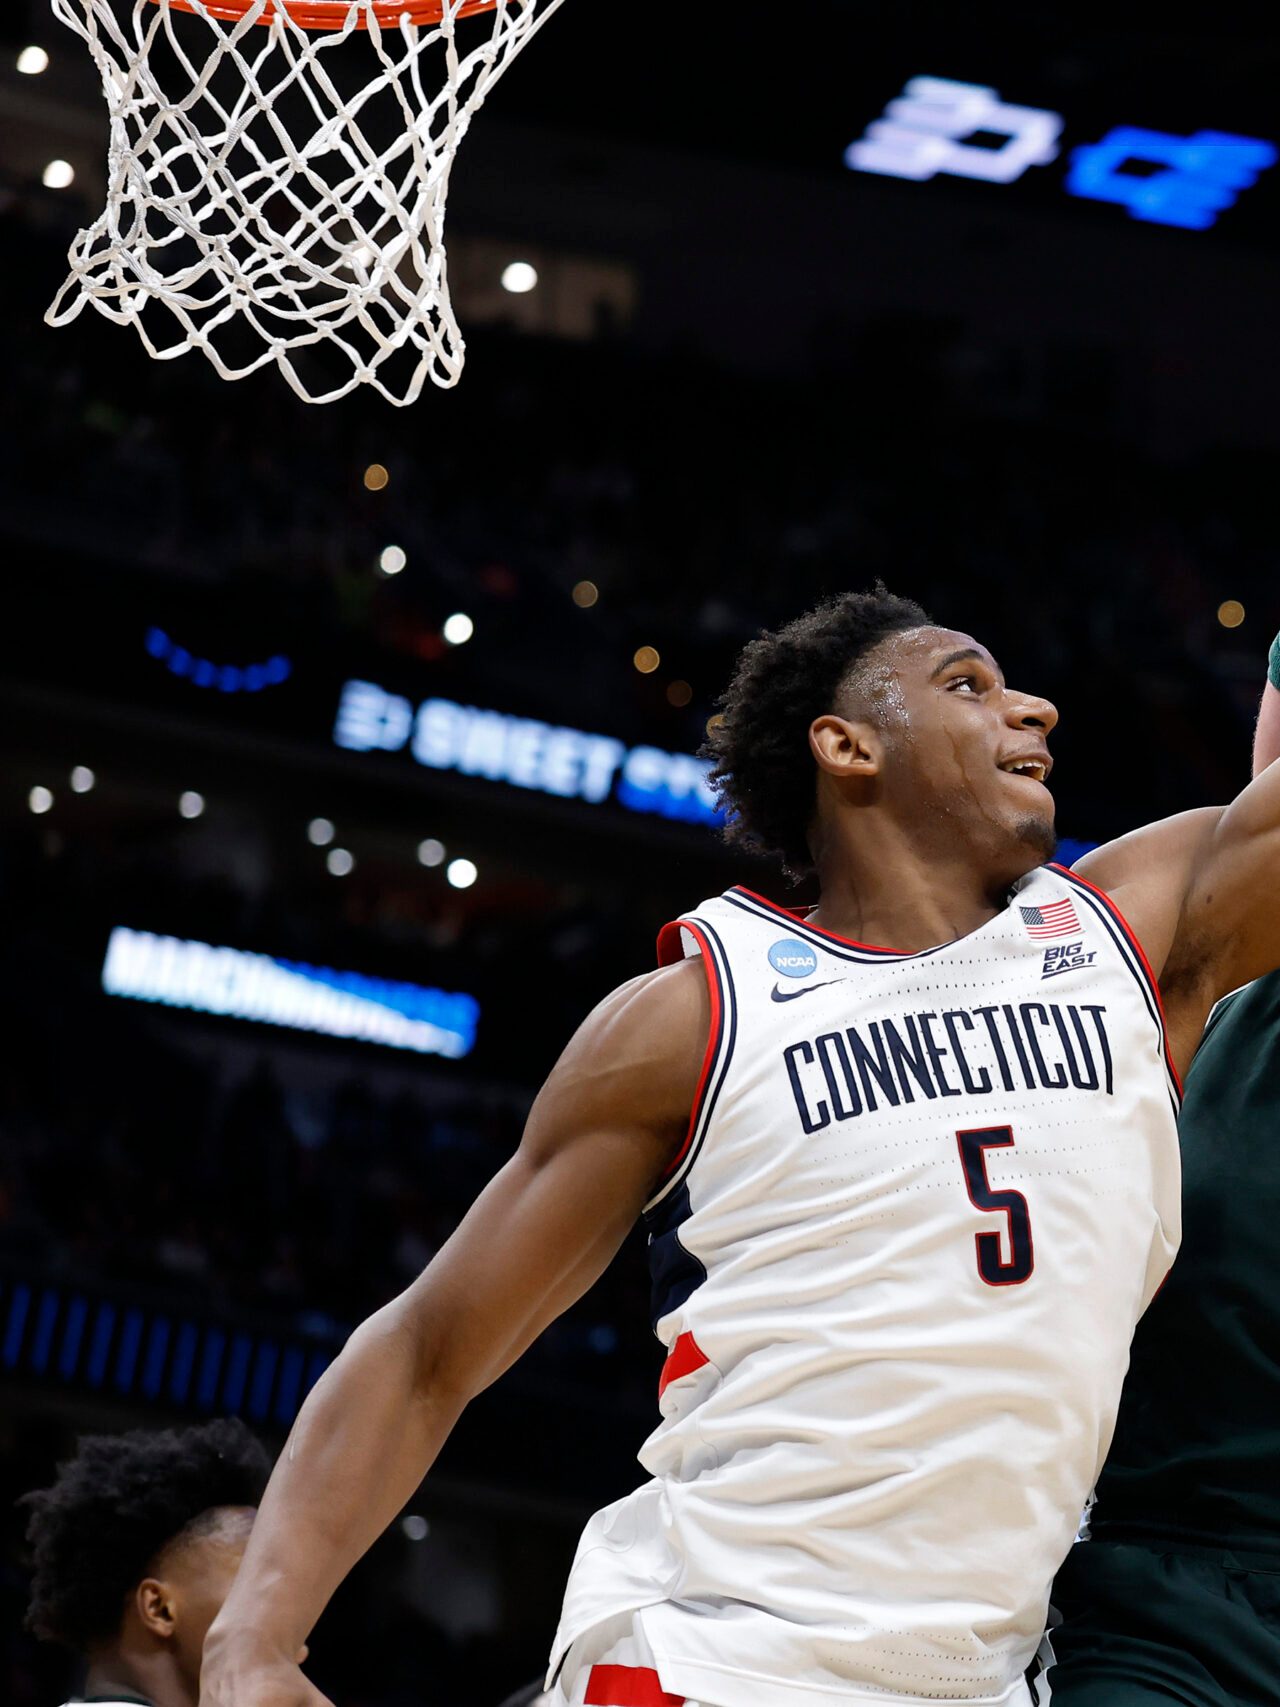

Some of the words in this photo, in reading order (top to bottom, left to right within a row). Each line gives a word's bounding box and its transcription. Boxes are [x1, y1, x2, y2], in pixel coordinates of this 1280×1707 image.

[411, 696, 627, 803] SWEET
[776, 956, 815, 968] NCAA
[1042, 951, 1098, 974] EAST
[1043, 941, 1083, 962] BIG
[783, 1002, 1114, 1134] CONNECTICUT
[956, 1125, 1035, 1288] 5
